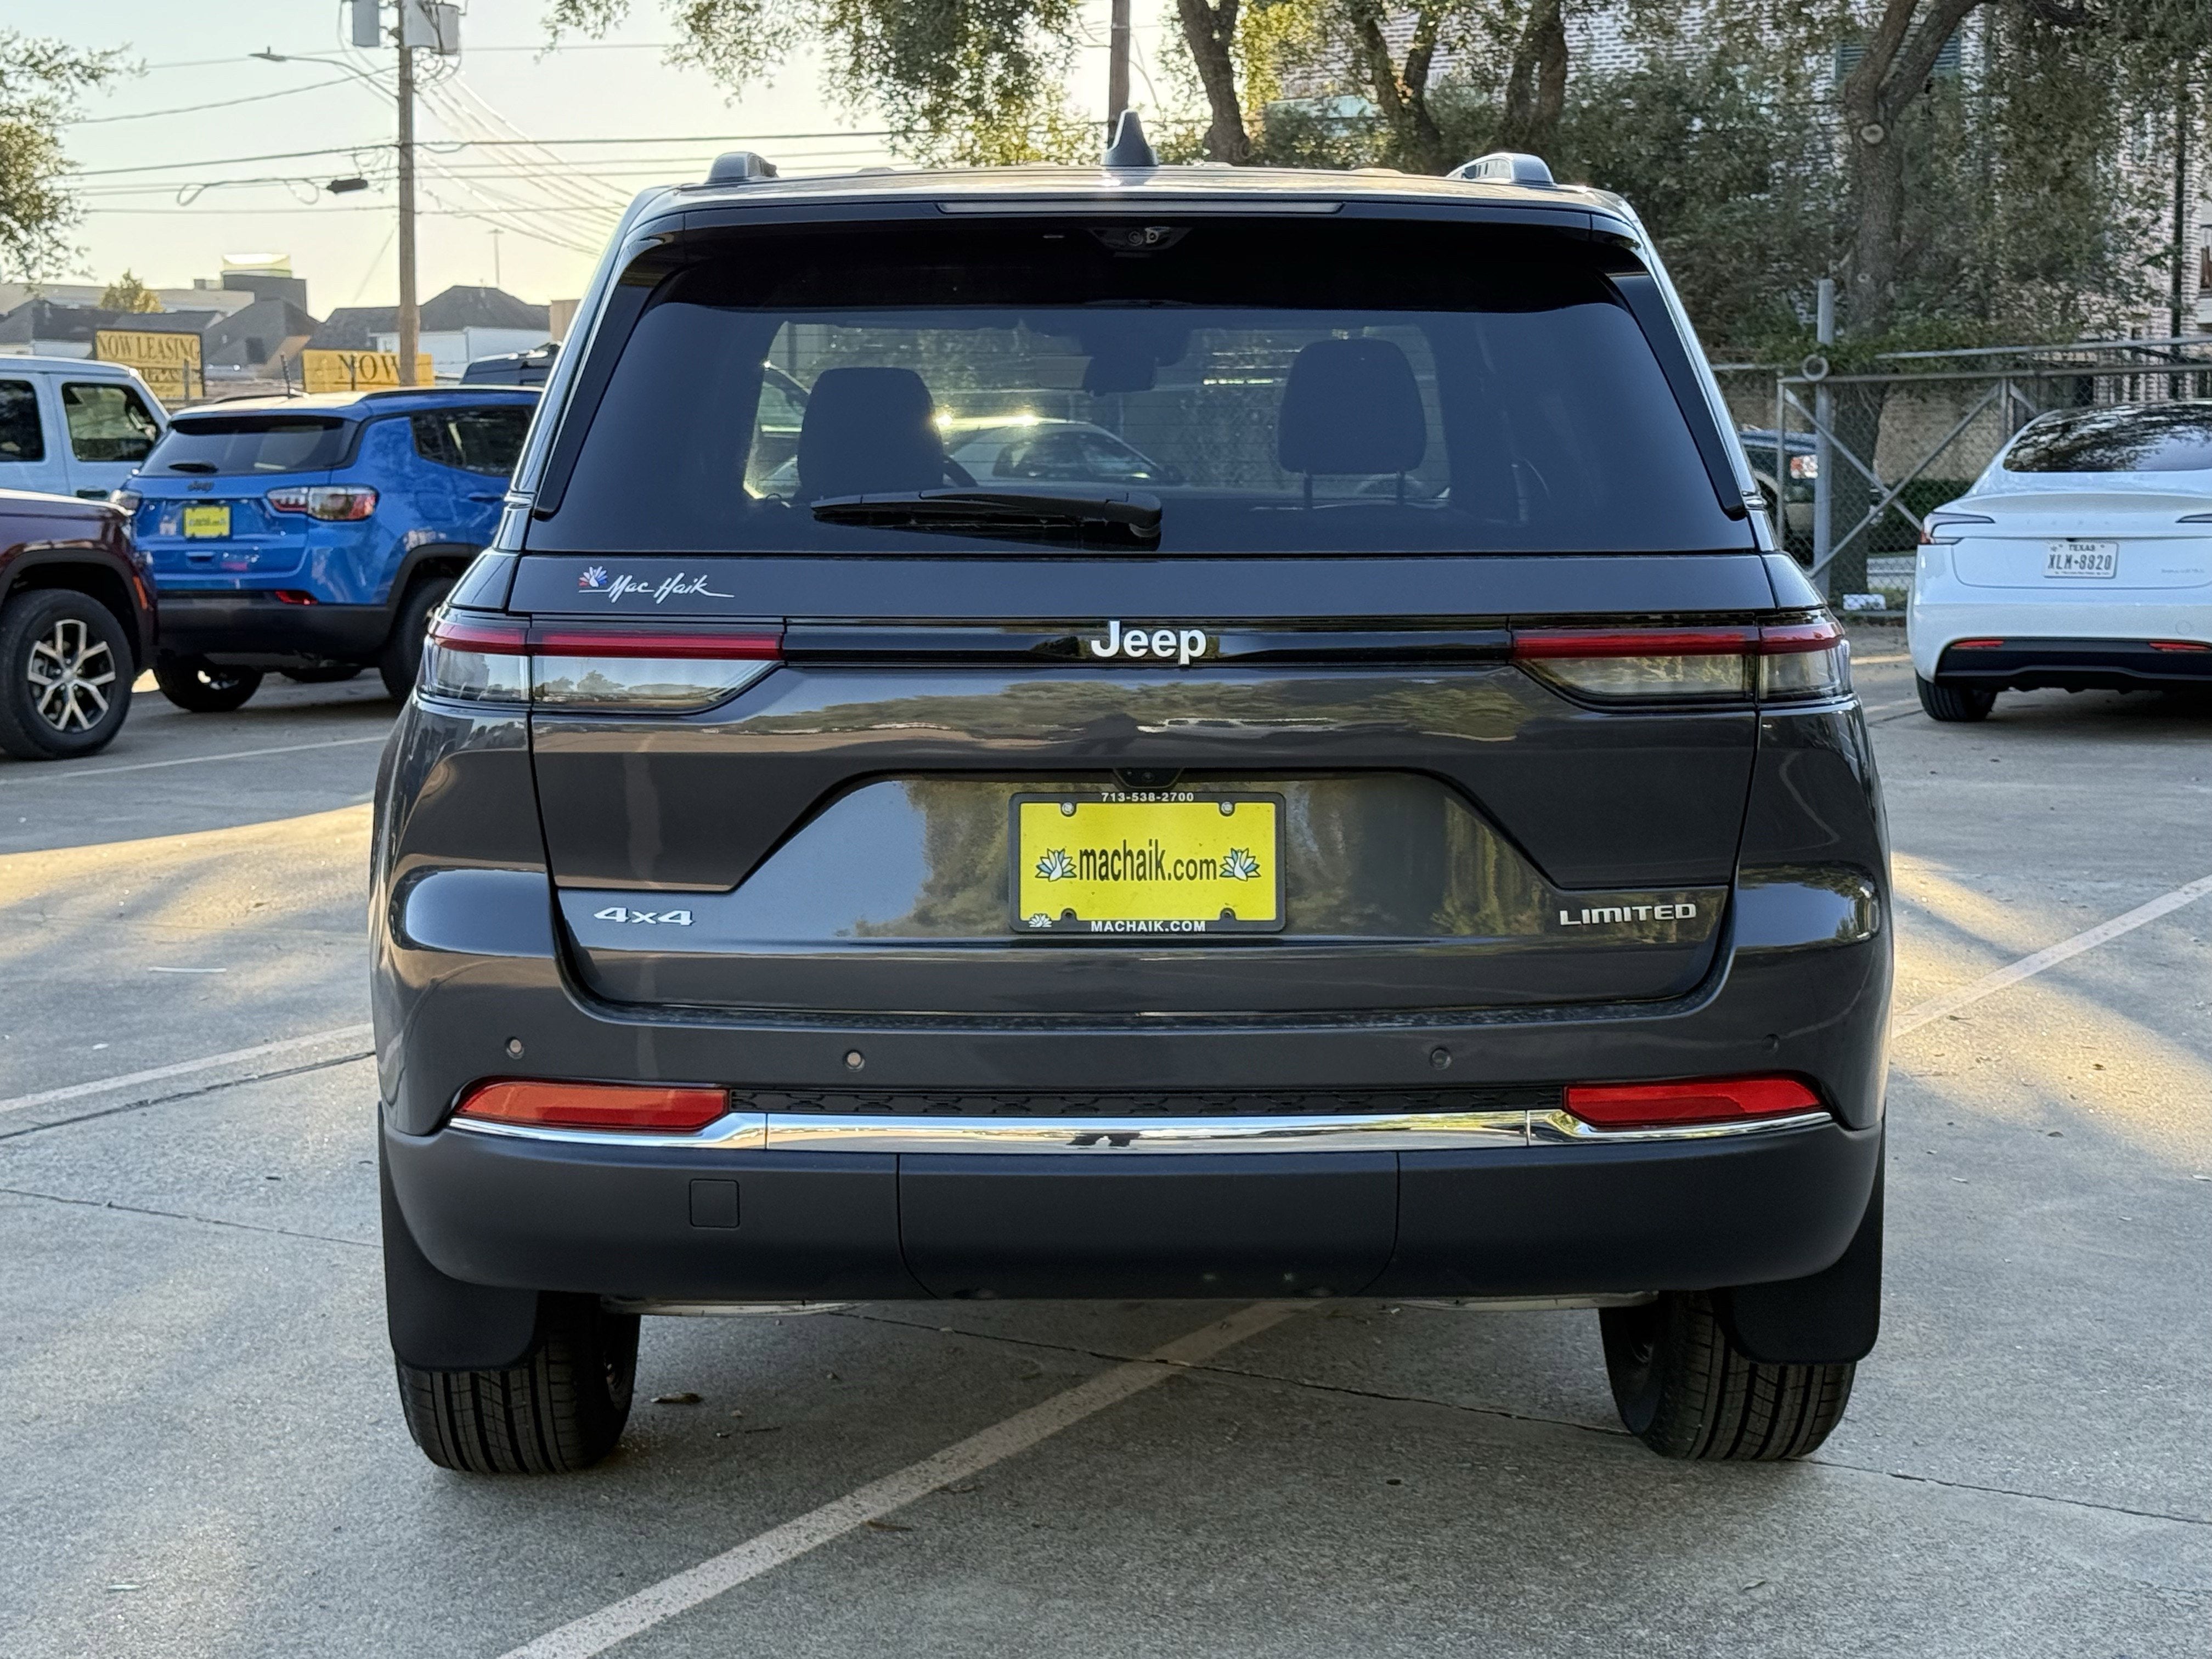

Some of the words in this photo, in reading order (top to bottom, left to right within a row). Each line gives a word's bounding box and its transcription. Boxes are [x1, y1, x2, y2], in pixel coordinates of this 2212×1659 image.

[97, 335, 133, 357] NOW
[137, 336, 200, 360] LEASING
[579, 575, 654, 603] Mac
[653, 572, 735, 604] Haik
[1091, 620, 1206, 665] Jeep
[1101, 792, 1194, 803] 713-538-2700
[1079, 839, 1217, 882] machaik.com
[593, 907, 694, 926] 4x4
[1090, 920, 1206, 933] MACHAIK.COM
[1559, 904, 1697, 926] LIMITED
